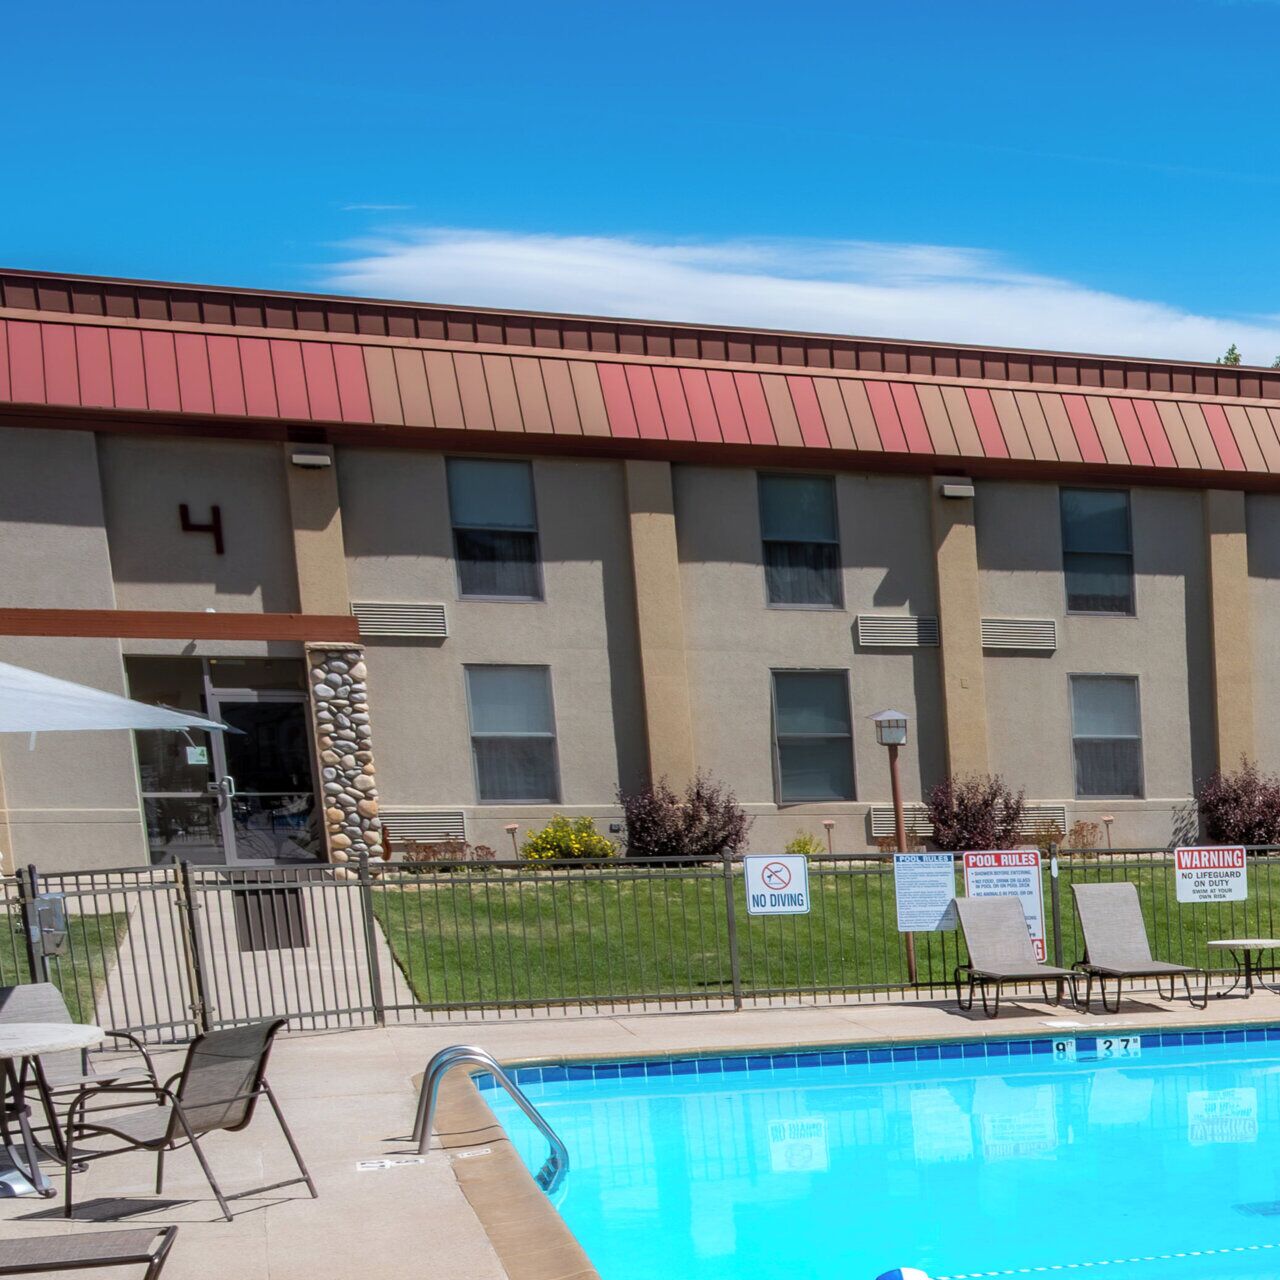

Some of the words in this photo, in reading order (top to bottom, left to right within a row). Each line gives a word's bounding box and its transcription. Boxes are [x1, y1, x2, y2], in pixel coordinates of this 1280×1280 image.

[178, 503, 224, 555] 4
[969, 855, 998, 867] POOL
[1001, 854, 1036, 866] RULES
[1179, 850, 1242, 868] WARNING
[1196, 871, 1241, 879] LIFEGUARD
[752, 894, 767, 908] NO
[770, 893, 804, 907] DIVING
[1056, 1042, 1066, 1052] 9
